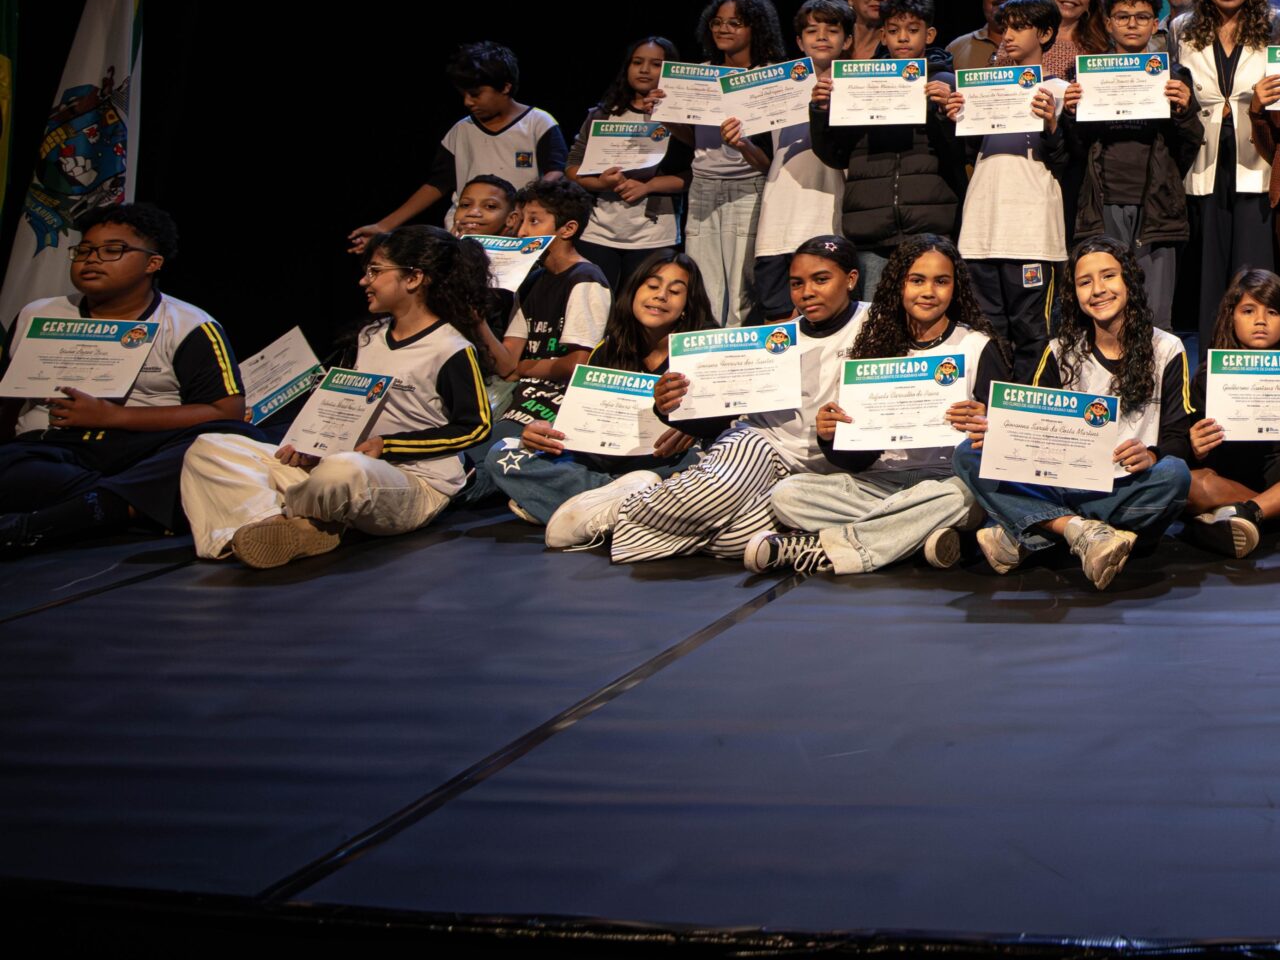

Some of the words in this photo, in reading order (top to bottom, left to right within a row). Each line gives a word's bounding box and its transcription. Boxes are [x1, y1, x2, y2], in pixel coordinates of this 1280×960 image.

[843, 63, 897, 72] CERTIFICADO
[1087, 57, 1139, 67] CERTIFICADO
[671, 66, 720, 77] CERTIFICADO
[729, 67, 784, 86] CERTIFICADO
[965, 70, 1014, 81] CERTIFICADO
[600, 124, 648, 132] CERTIFICADO
[42, 322, 118, 334] CERTIFICADO
[683, 331, 758, 348] CERTIFICADO
[857, 361, 928, 376] CERTIFICADO
[332, 373, 372, 388] CERTIFICADO
[586, 371, 654, 390] CERTIFICADO
[261, 376, 312, 414] ERTIFICADO
[1004, 389, 1078, 408] CERTIFICADO
